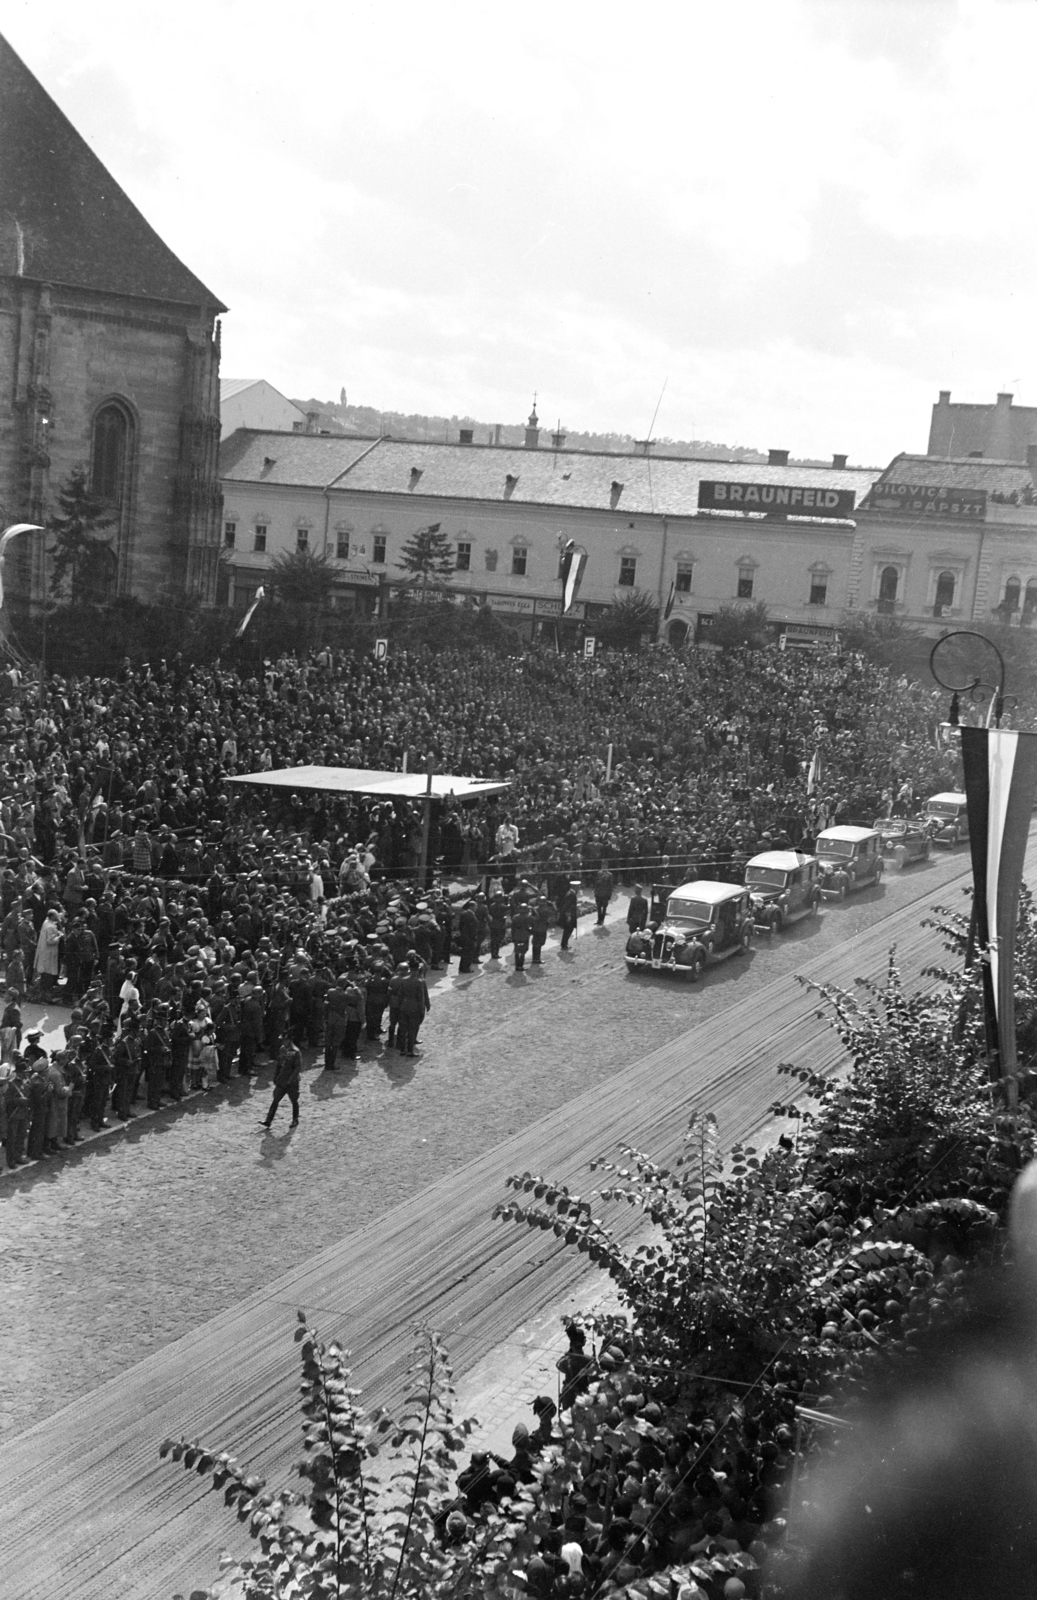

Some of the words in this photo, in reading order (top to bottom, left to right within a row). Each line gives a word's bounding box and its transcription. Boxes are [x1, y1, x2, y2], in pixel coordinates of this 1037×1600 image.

[713, 483, 839, 508] BRAUNFELD
[873, 484, 949, 498] GILOVICS
[787, 626, 833, 637] BRAUNFELD
[377, 641, 387, 658] D
[586, 639, 593, 654] E
